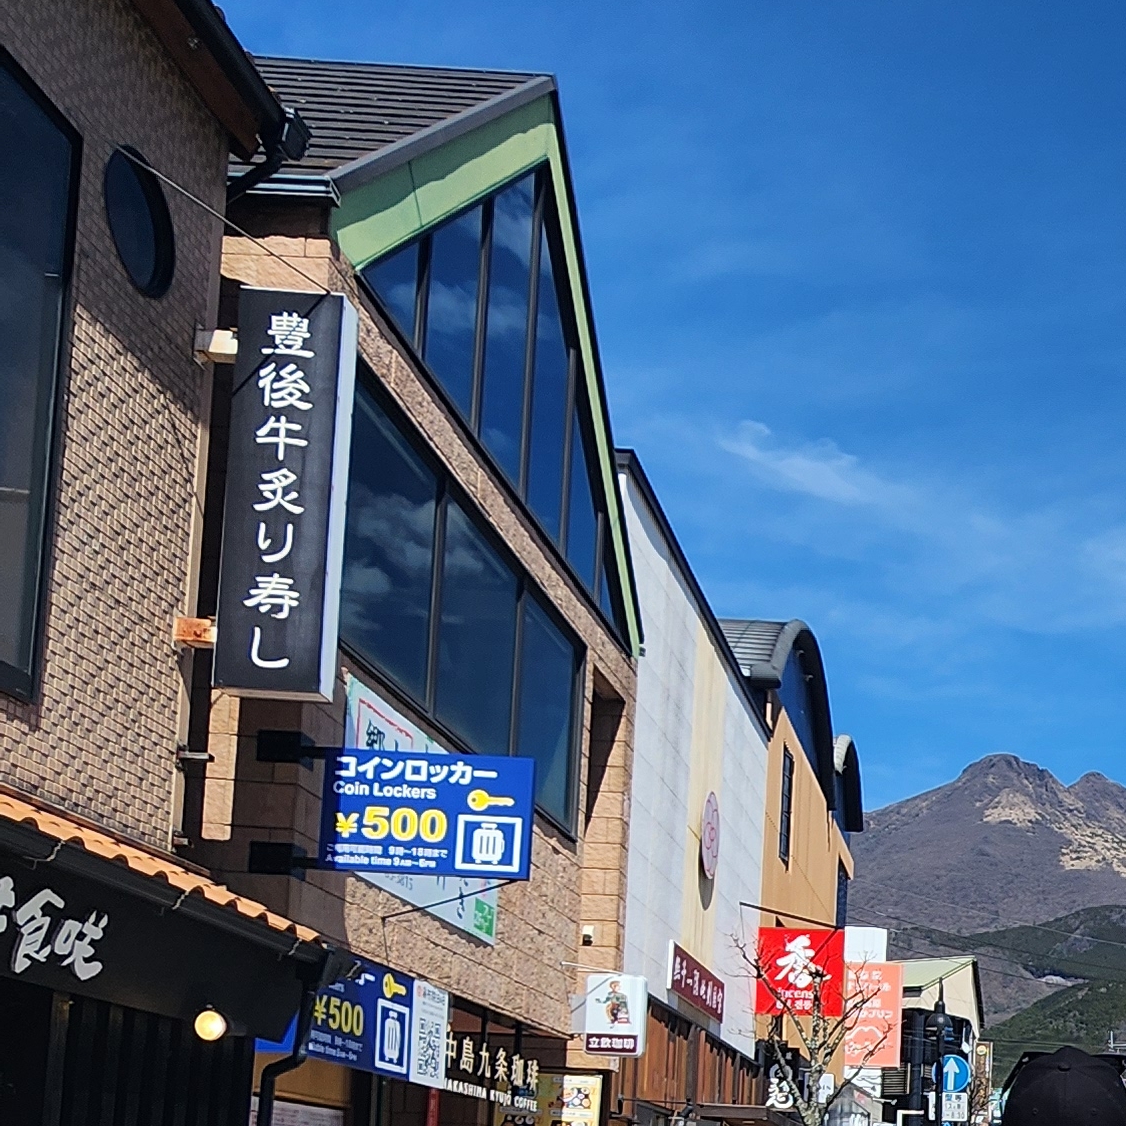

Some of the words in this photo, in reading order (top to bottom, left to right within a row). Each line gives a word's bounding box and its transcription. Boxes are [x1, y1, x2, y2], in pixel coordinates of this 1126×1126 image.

[243, 311, 314, 669] 豊後牛炙り寿し
[335, 755, 498, 785] コインロッカー
[333, 781, 369, 796] Coin
[373, 783, 437, 799] Lockers
[335, 805, 448, 843] ¥500
[314, 994, 364, 1036] ¥500
[514, 1096, 538, 1113] COFFEE
